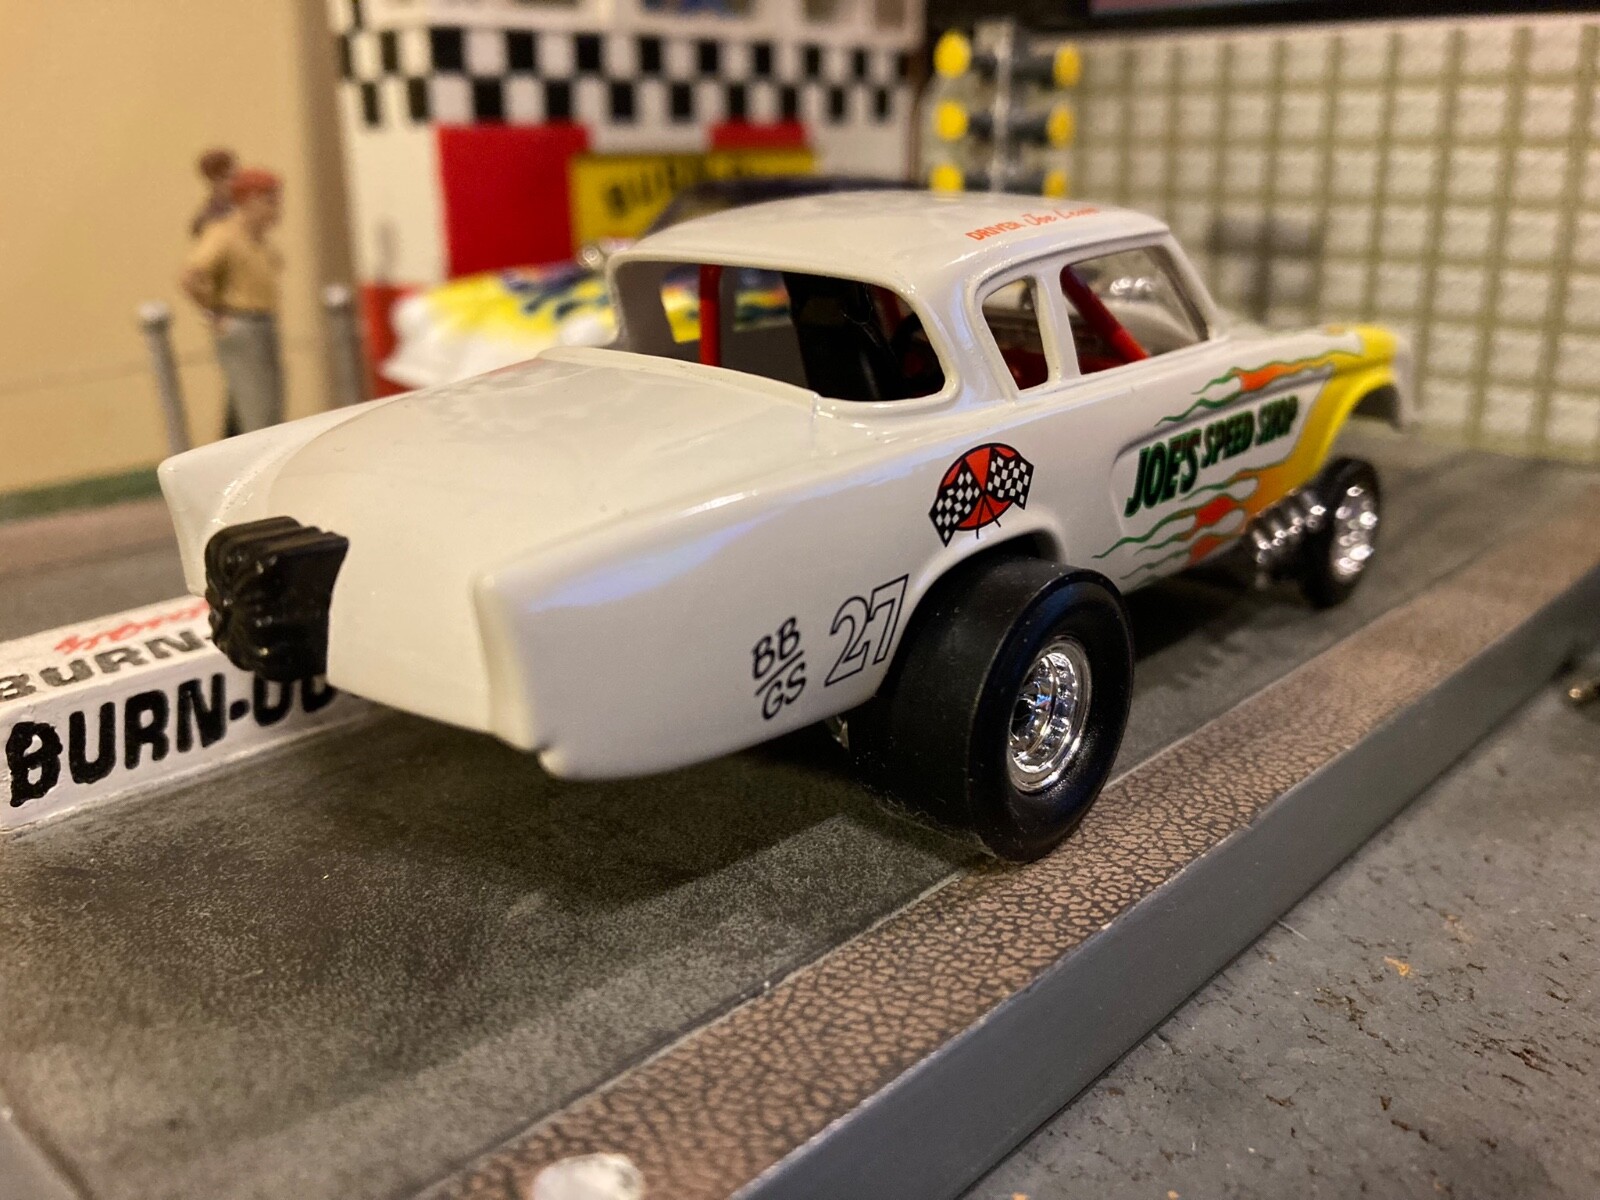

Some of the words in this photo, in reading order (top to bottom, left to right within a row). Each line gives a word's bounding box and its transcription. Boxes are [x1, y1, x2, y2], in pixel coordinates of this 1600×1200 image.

[1202, 410, 1255, 469] SPEED
[1256, 395, 1298, 446] SHOP
[752, 616, 801, 680] BB
[824, 573, 909, 687] 27
[762, 662, 807, 720] GS
